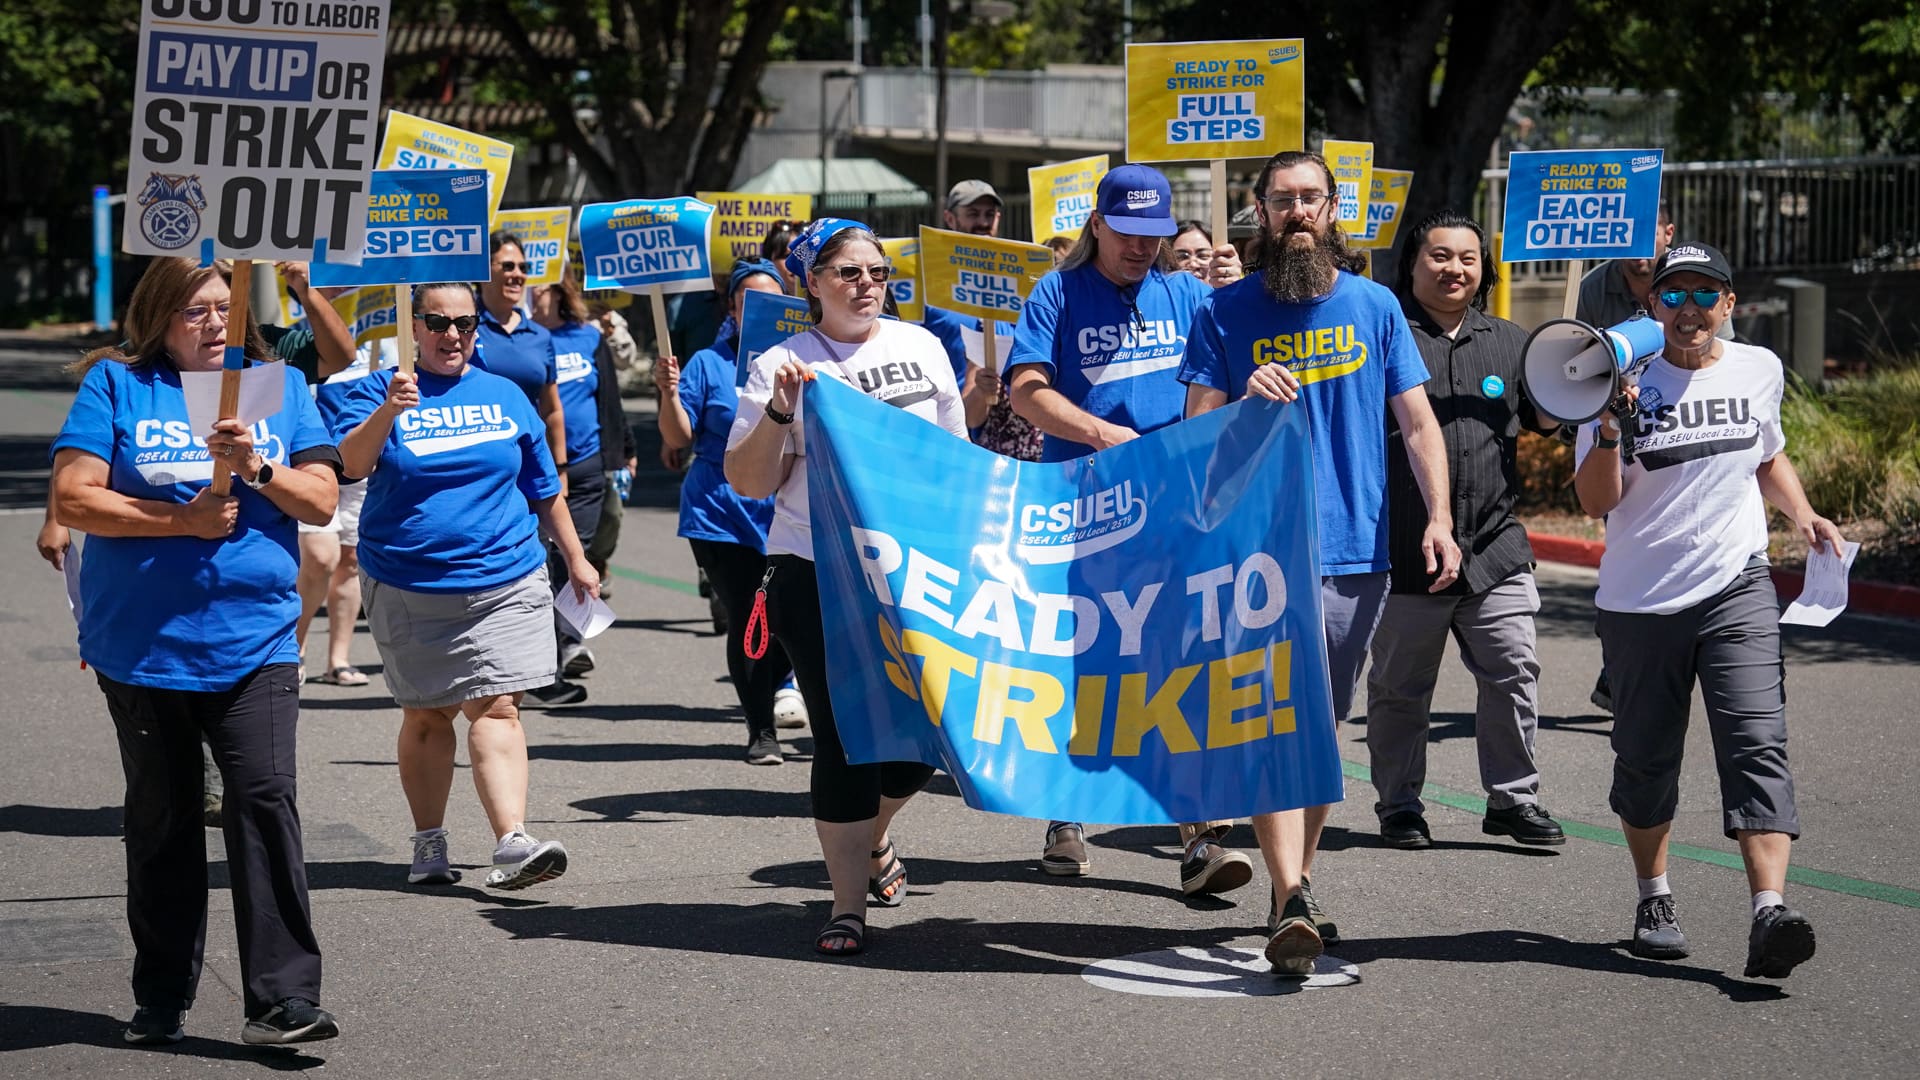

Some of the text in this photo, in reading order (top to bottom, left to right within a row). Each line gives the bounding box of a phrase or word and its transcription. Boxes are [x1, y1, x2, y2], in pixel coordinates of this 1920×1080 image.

[272, 1, 298, 26] TO
[305, 2, 380, 29] LABOR
[1268, 46, 1296, 57] CSUEU
[156, 40, 370, 100] PAY UP OR
[1175, 59, 1257, 74] READY TO
[1167, 74, 1265, 90] STRIKE FOR
[1181, 95, 1252, 118] FULL
[142, 98, 369, 171] STRIKE
[1171, 118, 1261, 142] STEPS
[422, 129, 461, 148] READY
[465, 142, 480, 154] TO
[414, 139, 483, 166] STRIKE FOR
[1631, 155, 1657, 166] CSUEU
[1549, 164, 1598, 177] READY
[1602, 163, 1622, 175] TO
[451, 175, 481, 186] CSUEU
[1541, 177, 1627, 192] STRIKE FOR
[368, 193, 440, 208] EADY TO
[1127, 189, 1157, 200] CSUEU
[1338, 183, 1357, 200] FULL
[218, 176, 363, 250] OUT
[613, 205, 657, 217] READY
[659, 205, 677, 213] TO
[717, 200, 742, 216] WE
[749, 200, 792, 217] MAKE
[1056, 196, 1092, 213] FULL
[1338, 202, 1359, 219] TEPS
[1541, 196, 1622, 220] EACH
[368, 208, 449, 223] RIKE FOR
[608, 212, 679, 229] STRIKE FOR
[720, 220, 769, 237] AMERI
[1529, 221, 1629, 246] OTHER
[366, 229, 476, 255] SPECT
[621, 229, 673, 253] OUR
[600, 248, 695, 277] DIGNITY
[954, 245, 997, 260] READY
[1000, 252, 1018, 264] TO
[949, 255, 1025, 275] STRIKE FOR
[961, 271, 1015, 294] FULL
[955, 287, 1023, 311] STEPS
[784, 307, 812, 322] REA
[1078, 320, 1177, 354] CSUEU
[1253, 324, 1355, 366] CSUEU
[1081, 353, 1104, 366] CSEA
[1112, 351, 1131, 361] SEIU
[1132, 349, 1151, 359] Local
[1152, 347, 1175, 357] 2579
[1307, 359, 1329, 368] Local
[1329, 353, 1352, 364] 2579
[857, 361, 923, 394] UEU
[400, 404, 503, 432] CSUEU
[1633, 398, 1750, 438] CSUEU
[402, 430, 427, 441] CSEA
[433, 427, 455, 437] SEIU
[456, 426, 478, 436] Local
[479, 424, 502, 433] 2579
[1668, 432, 1693, 445] SEIU
[1695, 431, 1720, 441] Local
[1722, 427, 1748, 438] 2579
[135, 450, 170, 464] CSEA
[180, 449, 209, 461] SEIU
[1020, 479, 1133, 533] CSUEU
[1020, 534, 1050, 545] CSEA
[1059, 531, 1086, 544] SEIU
[1087, 524, 1108, 538] Local
[1110, 514, 1132, 530] 2579
[850, 525, 1288, 657] READY TO
[878, 613, 1297, 757] STRIKE!
